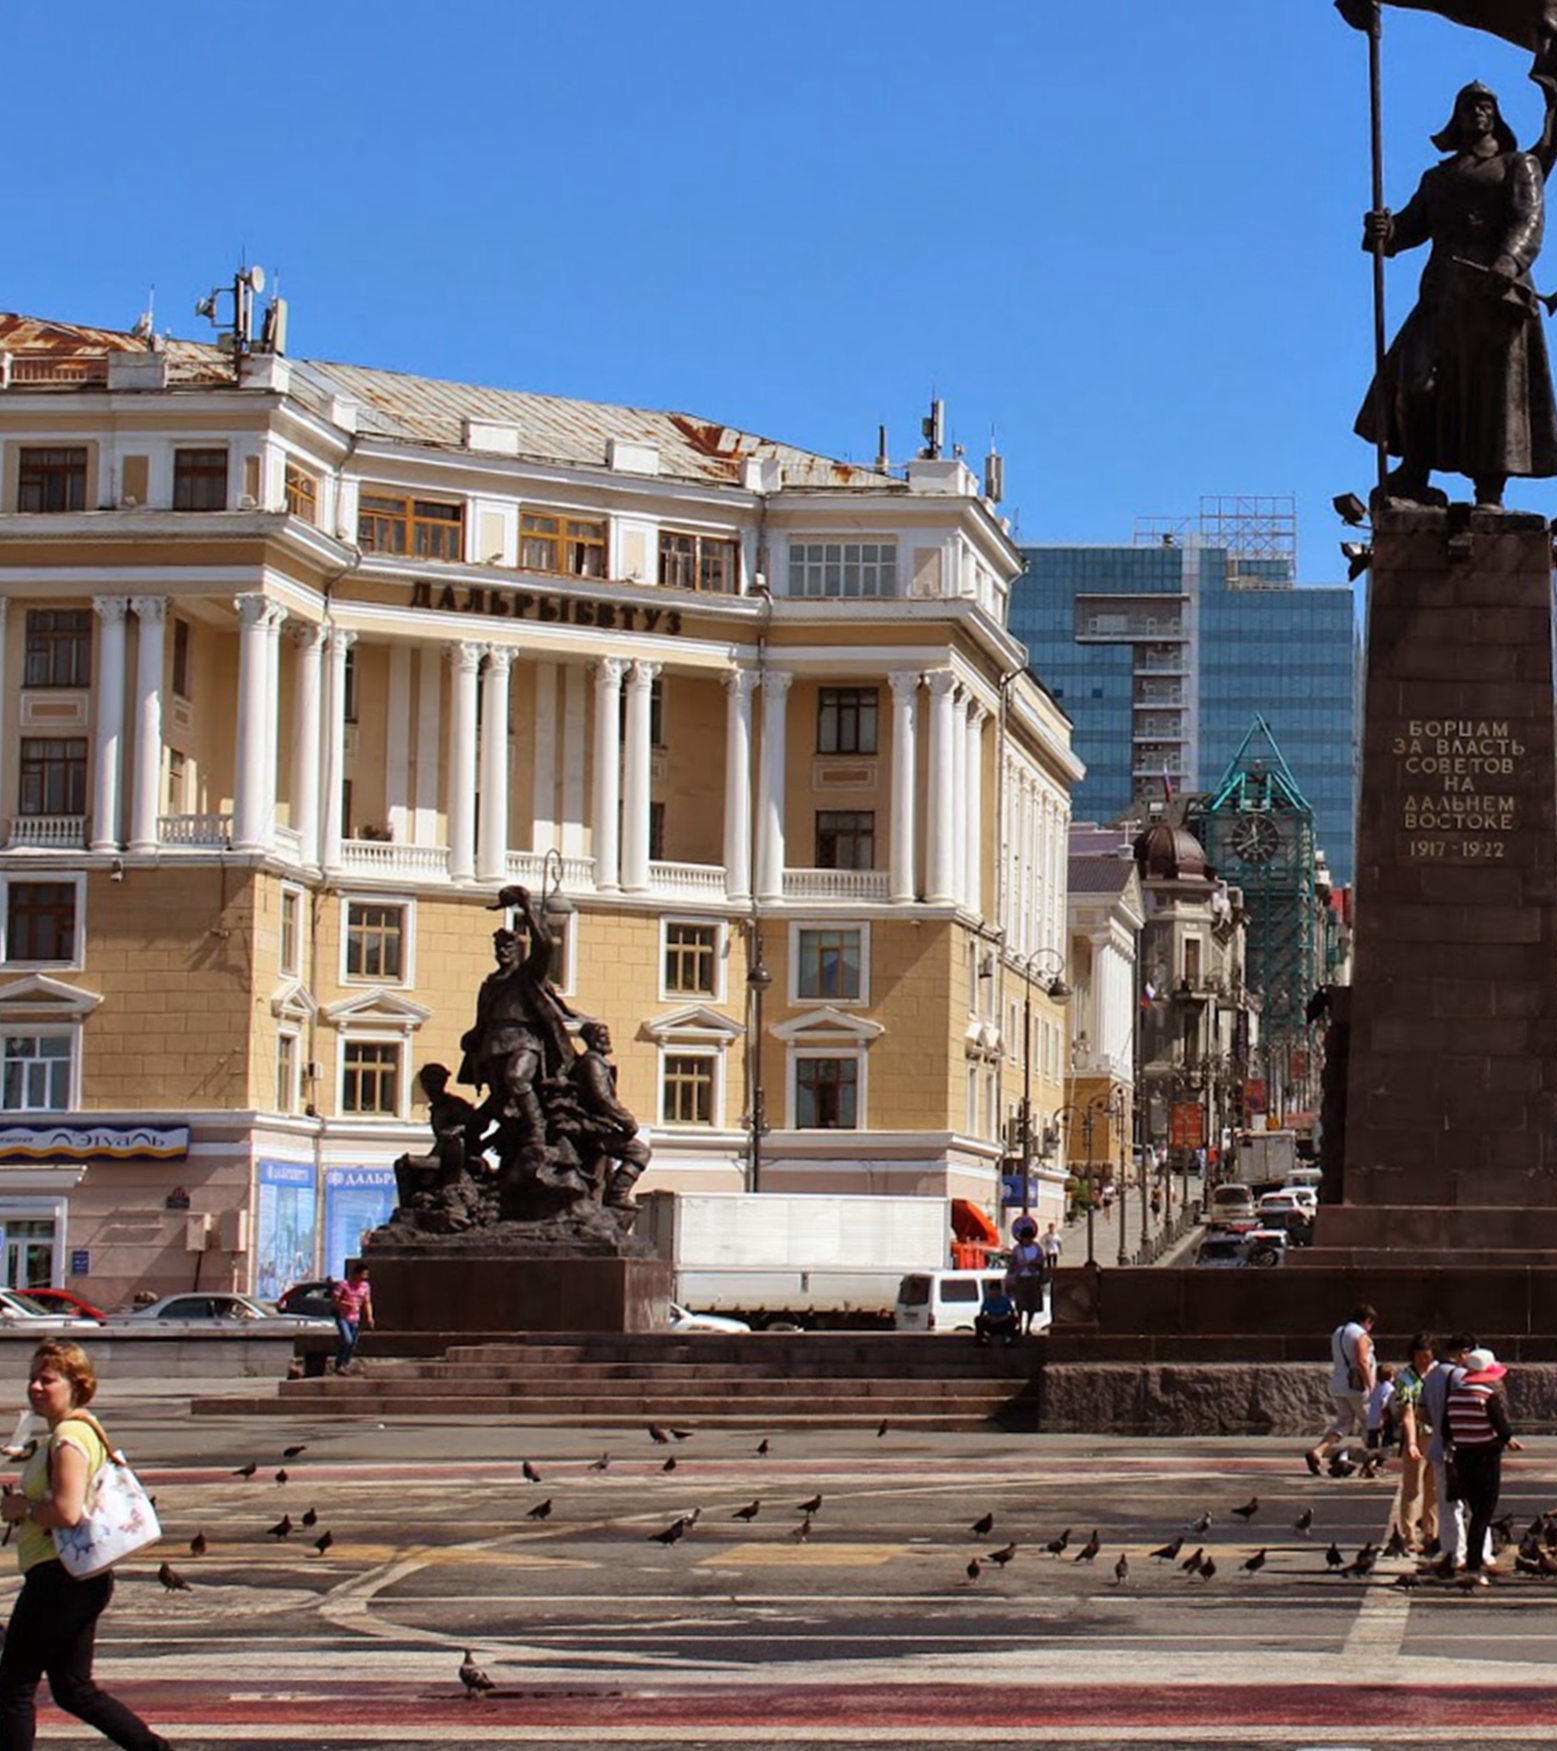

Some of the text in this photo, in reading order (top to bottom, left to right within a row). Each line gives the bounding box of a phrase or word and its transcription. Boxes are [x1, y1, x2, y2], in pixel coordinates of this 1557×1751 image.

[409, 580, 683, 636] ДАЛЬРЫБВТУЗ
[1409, 721, 1508, 737] БОРЦАМ
[1392, 738, 1526, 756] ЗА ВЛАСТЬ
[1405, 757, 1514, 774] СОВЕТОВ
[1444, 776, 1475, 792] НА
[1404, 795, 1515, 812] ДАЛЬНЕМ
[1404, 813, 1513, 829] ВОСТОКЕ
[1410, 841, 1446, 857] 1917
[1462, 841, 1504, 857] 1922
[345, 1171, 397, 1186] ДАЛЬР
